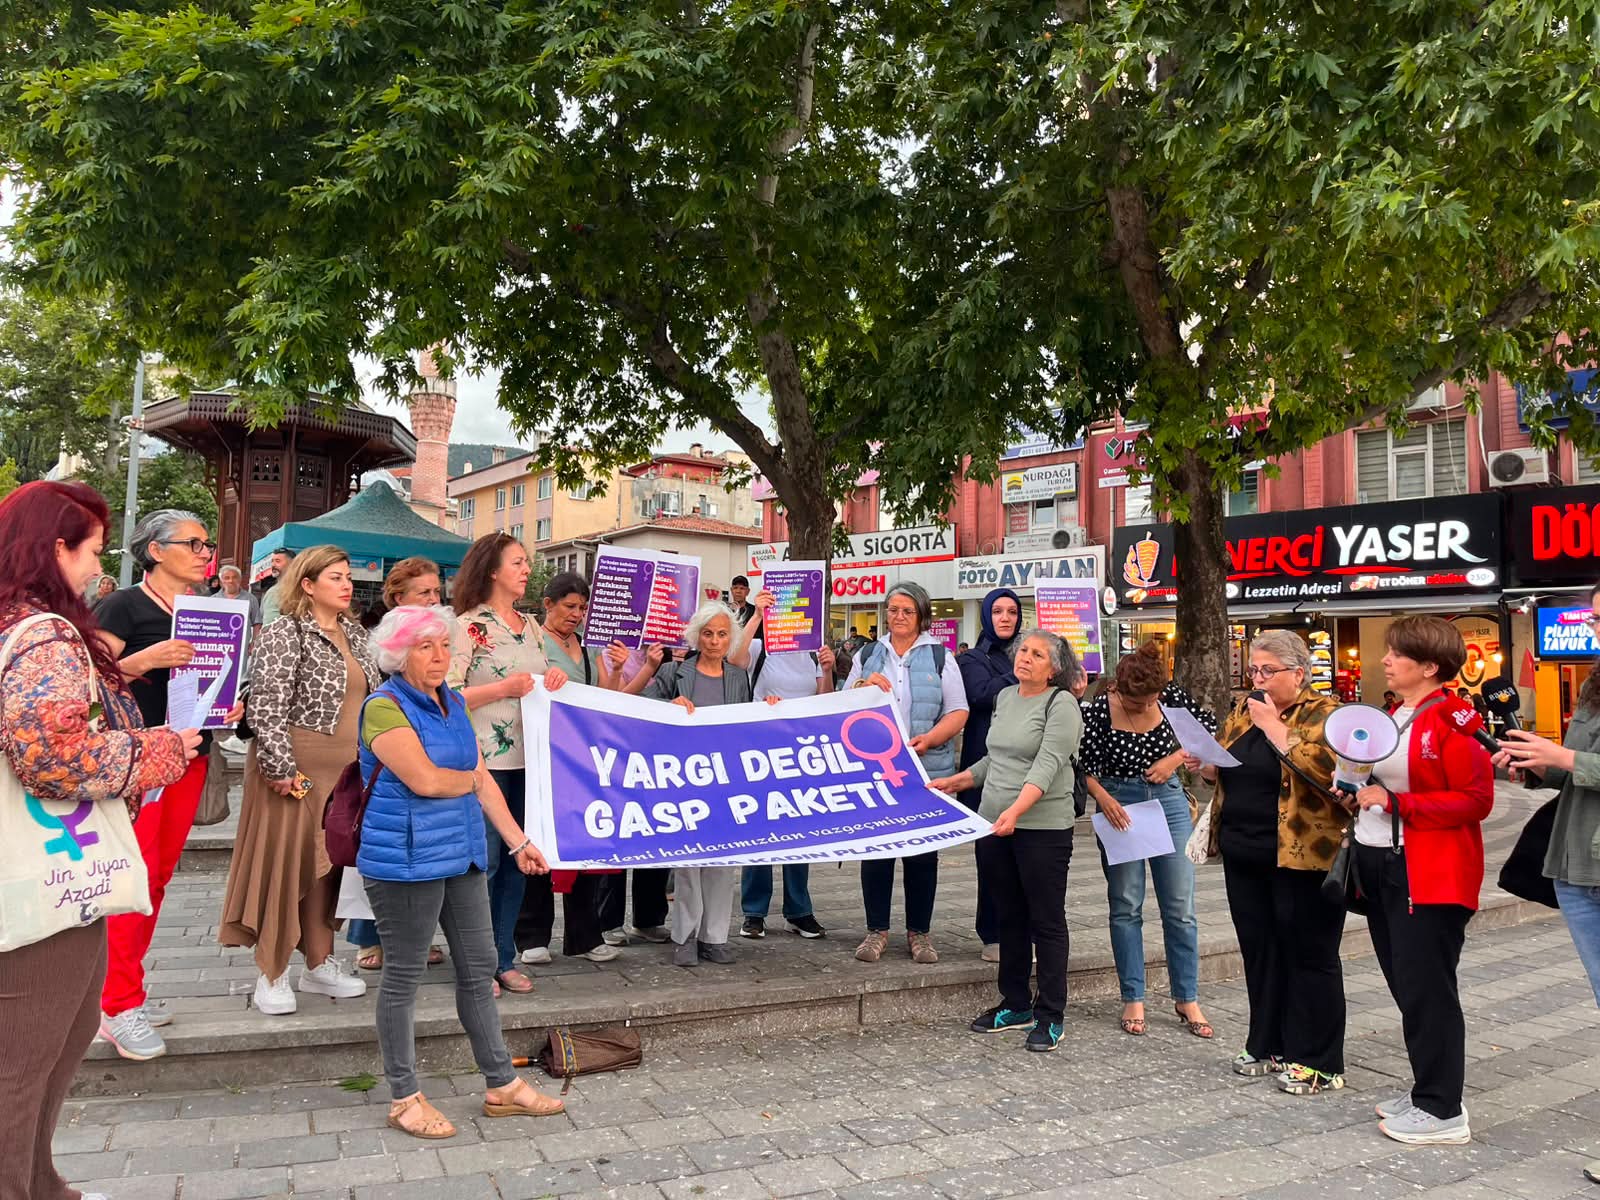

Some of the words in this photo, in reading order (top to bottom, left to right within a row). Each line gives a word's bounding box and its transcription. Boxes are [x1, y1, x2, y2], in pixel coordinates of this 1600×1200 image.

[1023, 466, 1071, 482] NURDAĞI
[1332, 520, 1488, 566] YASER
[833, 574, 886, 597] OSCH
[959, 568, 998, 585] FOTO
[999, 558, 1095, 587] AYHAN
[1391, 575, 1426, 586] DÖNER
[1245, 584, 1297, 598] Lezzetin
[1299, 581, 1342, 596] Adresi
[1543, 637, 1588, 651] TAVUK
[1544, 623, 1595, 638] PİLAVÜS
[589, 745, 730, 789] YARGI
[739, 734, 866, 783] DEĞİL
[584, 799, 711, 839] GASP
[728, 771, 899, 825] PAKETİ
[658, 831, 807, 859] haklarımızdan
[807, 808, 948, 838] vazgeçmiyoruz
[833, 827, 977, 857] PLATFORMU
[44, 868, 75, 886] Jin
[86, 857, 131, 877] Jiyan
[55, 878, 112, 909] Azadî
